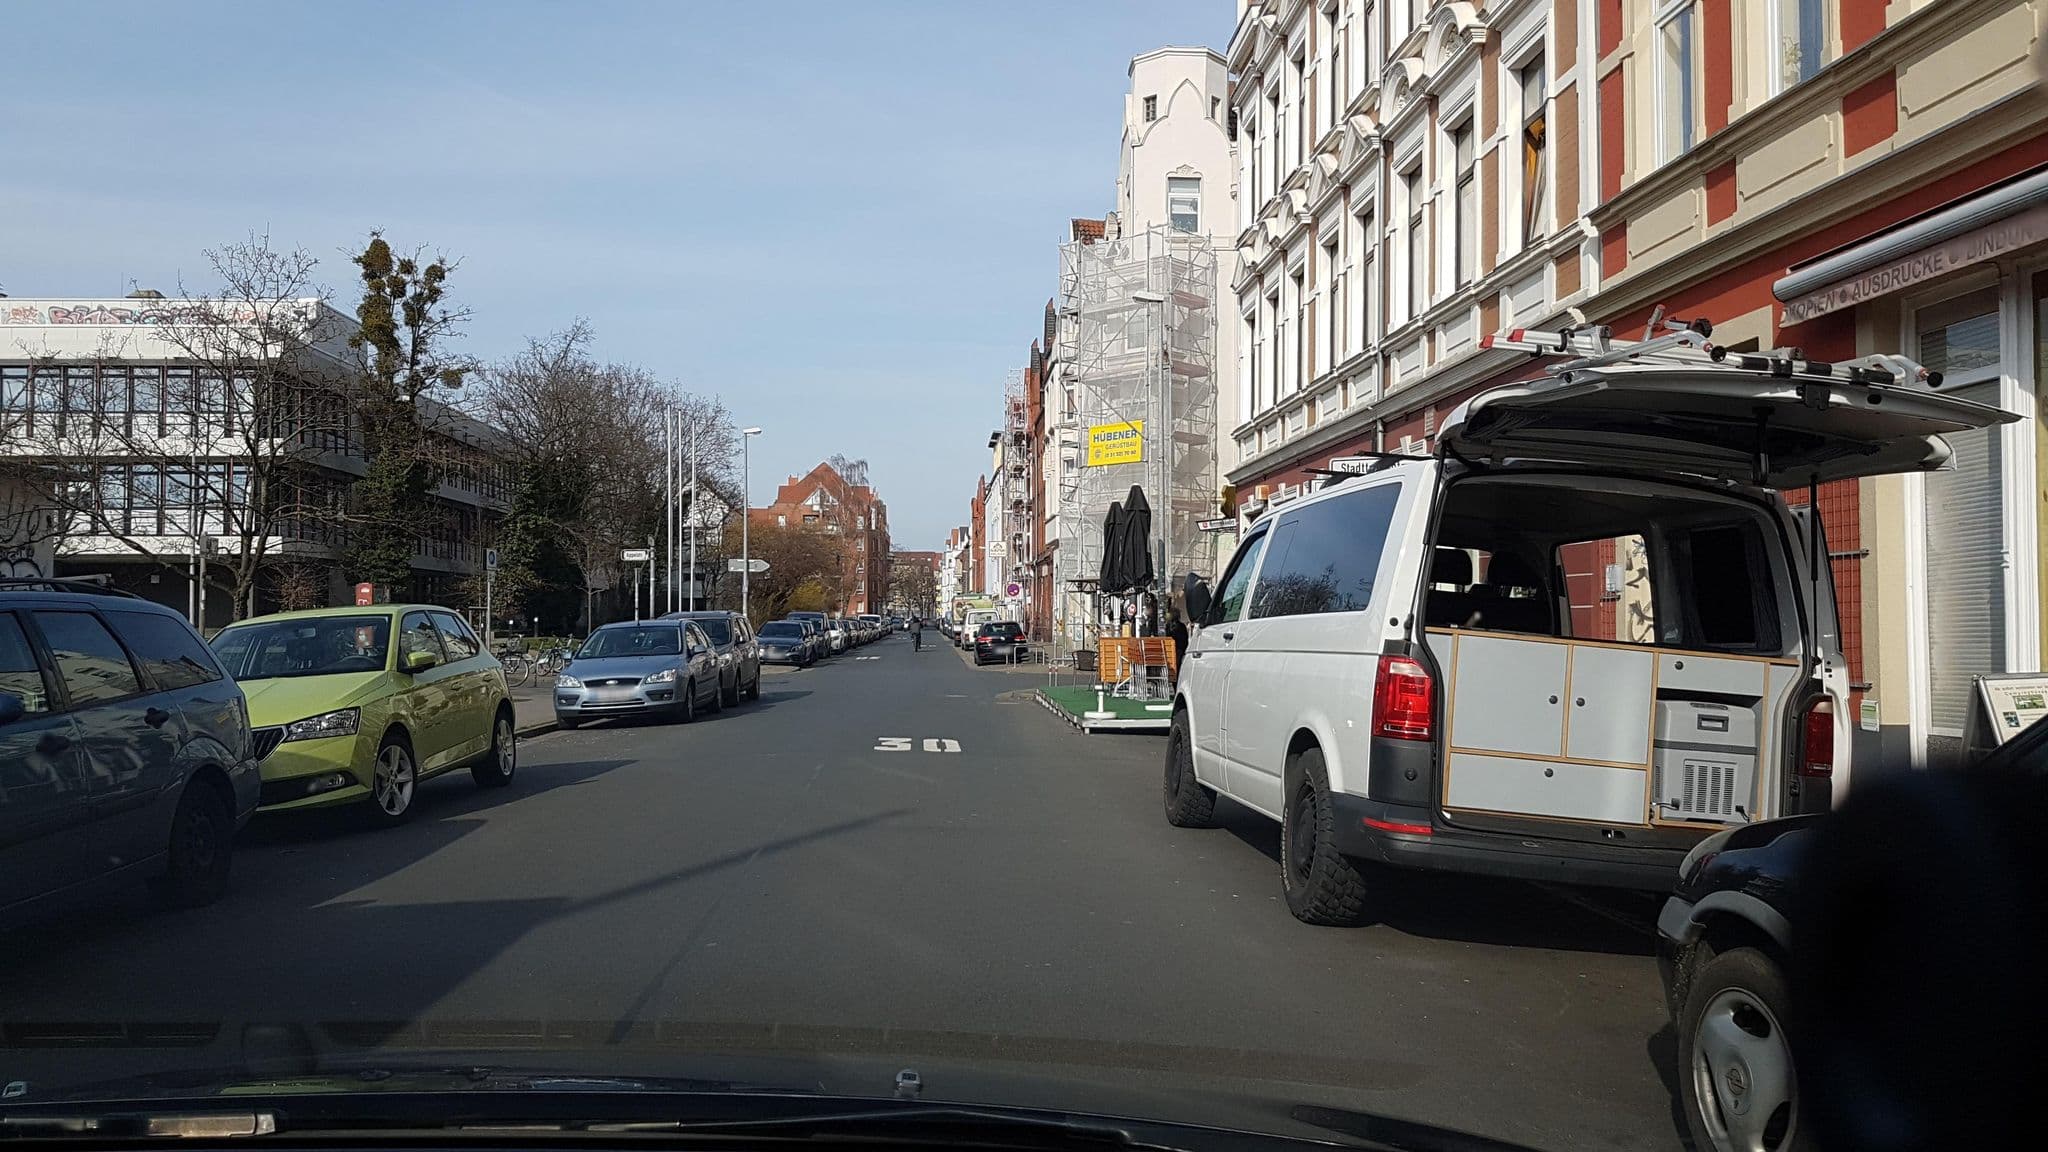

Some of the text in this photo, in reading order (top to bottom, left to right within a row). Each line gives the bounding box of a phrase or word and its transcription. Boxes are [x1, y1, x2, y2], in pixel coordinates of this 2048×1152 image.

[1851, 252, 1944, 301] AUSDRUCKE
[1093, 429, 1137, 443] HÜBENER
[874, 737, 961, 752] 30
